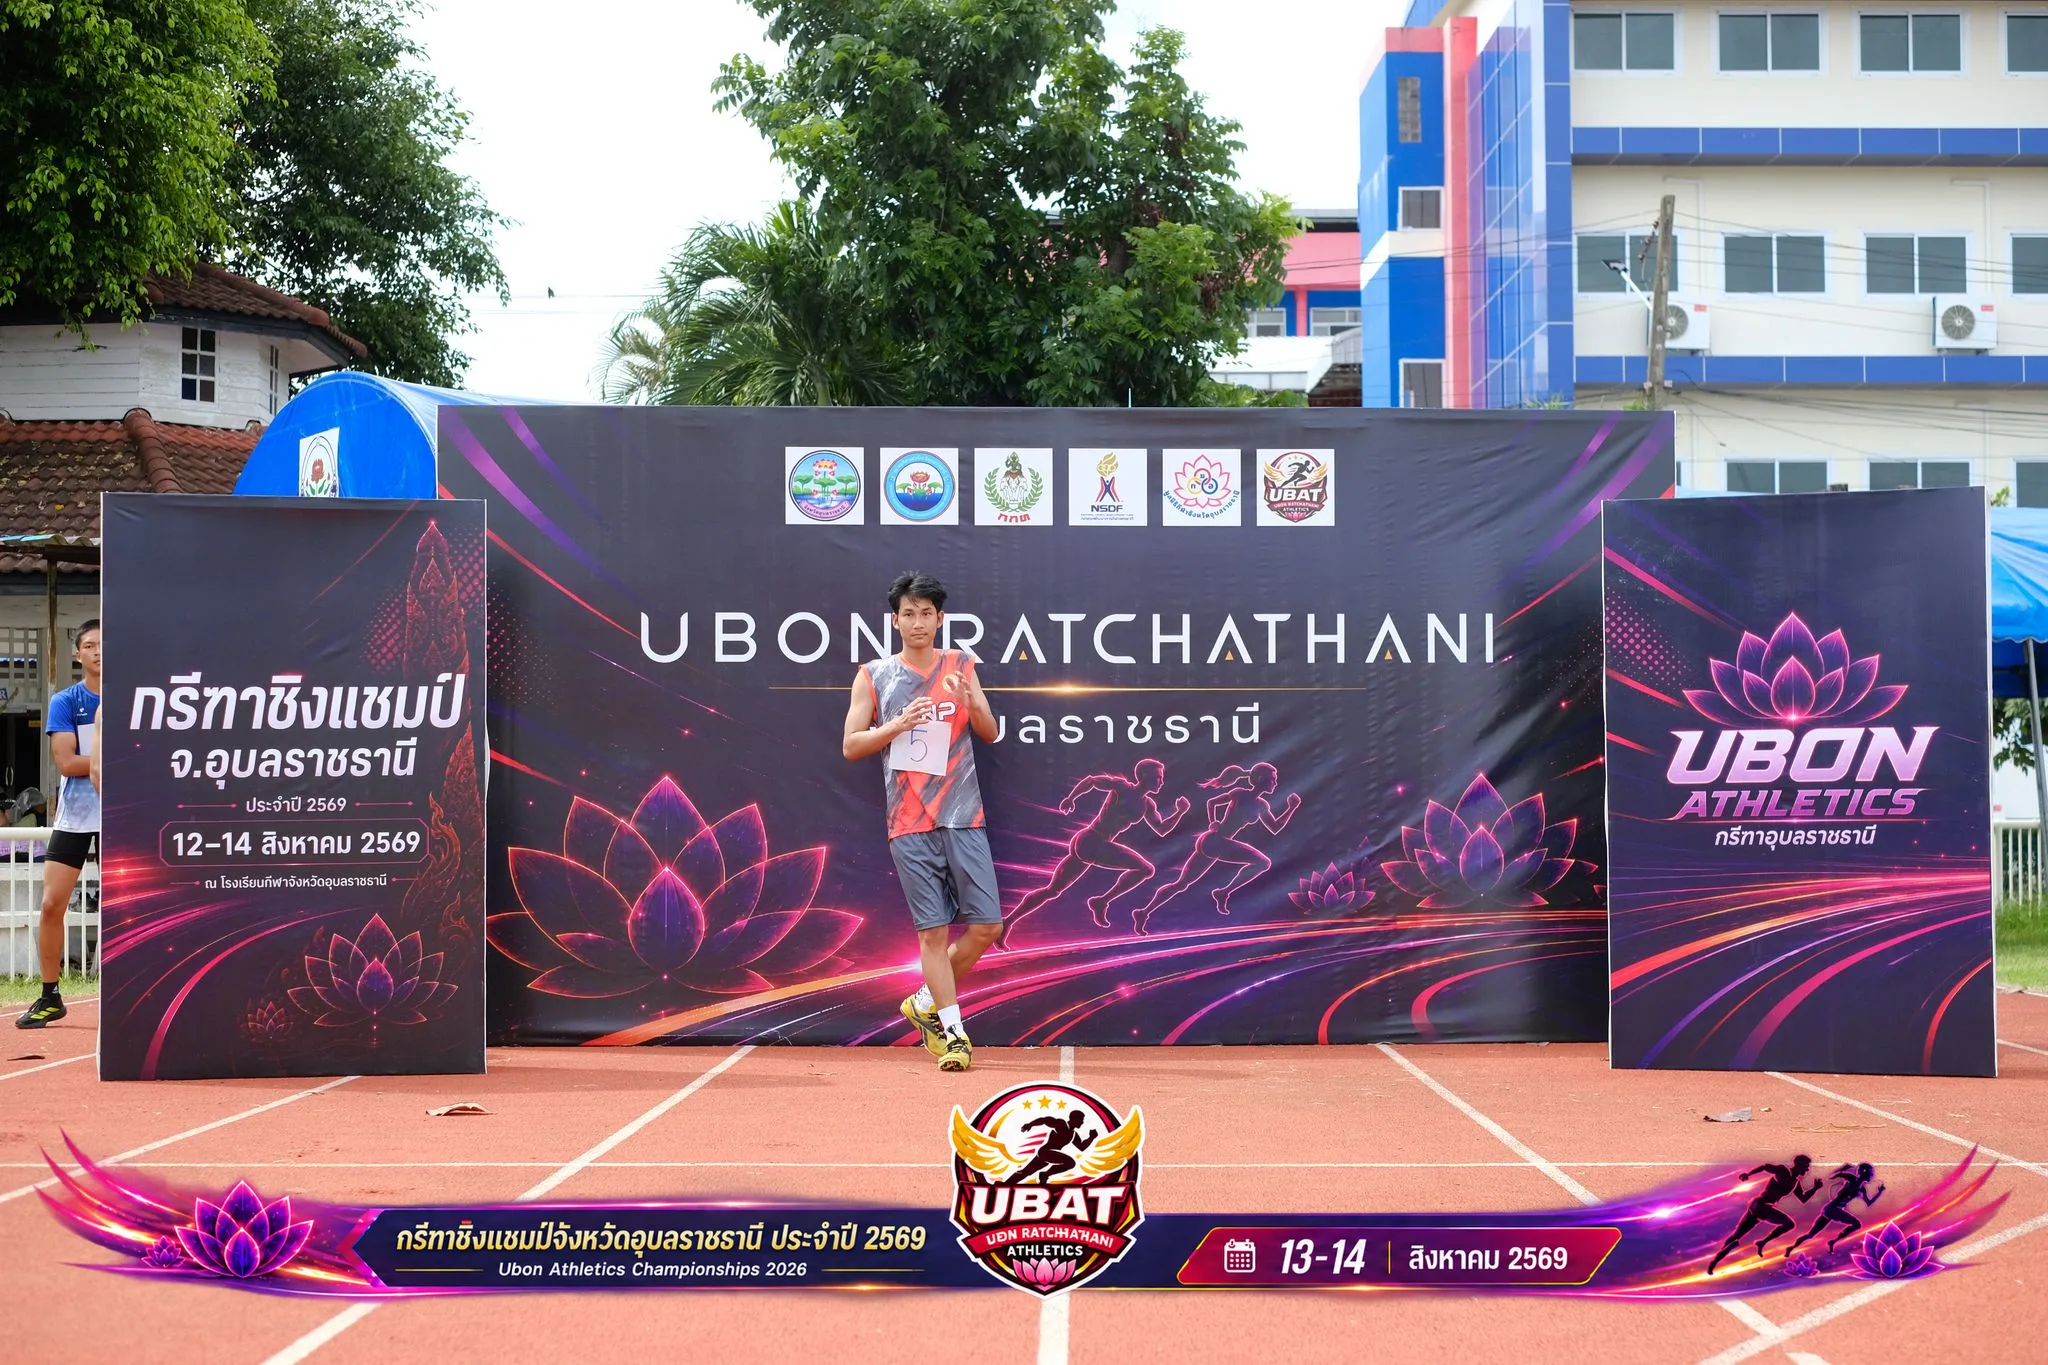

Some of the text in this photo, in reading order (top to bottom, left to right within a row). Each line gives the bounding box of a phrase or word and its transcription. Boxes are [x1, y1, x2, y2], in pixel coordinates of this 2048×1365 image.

[1269, 488, 1322, 502] UBAT
[641, 612, 1493, 664] UBON RATCHATHANI
[130, 672, 466, 729] กรีฑาชิงแชมป์
[910, 729, 928, 762] 5
[1667, 727, 1940, 784] UBON
[170, 737, 417, 790] จ.อุบลราชธานี
[246, 796, 347, 813] ประจำปี 2569
[1666, 788, 1935, 821] ATHLETICS
[261, 831, 352, 856] สิงหาคม
[360, 831, 421, 854] 2569
[1715, 824, 1877, 851] กรีฑาอุบลราชธานี
[204, 873, 388, 890] ณ โรงเรียนกีฬาจังหวัดอุบลราชธานี
